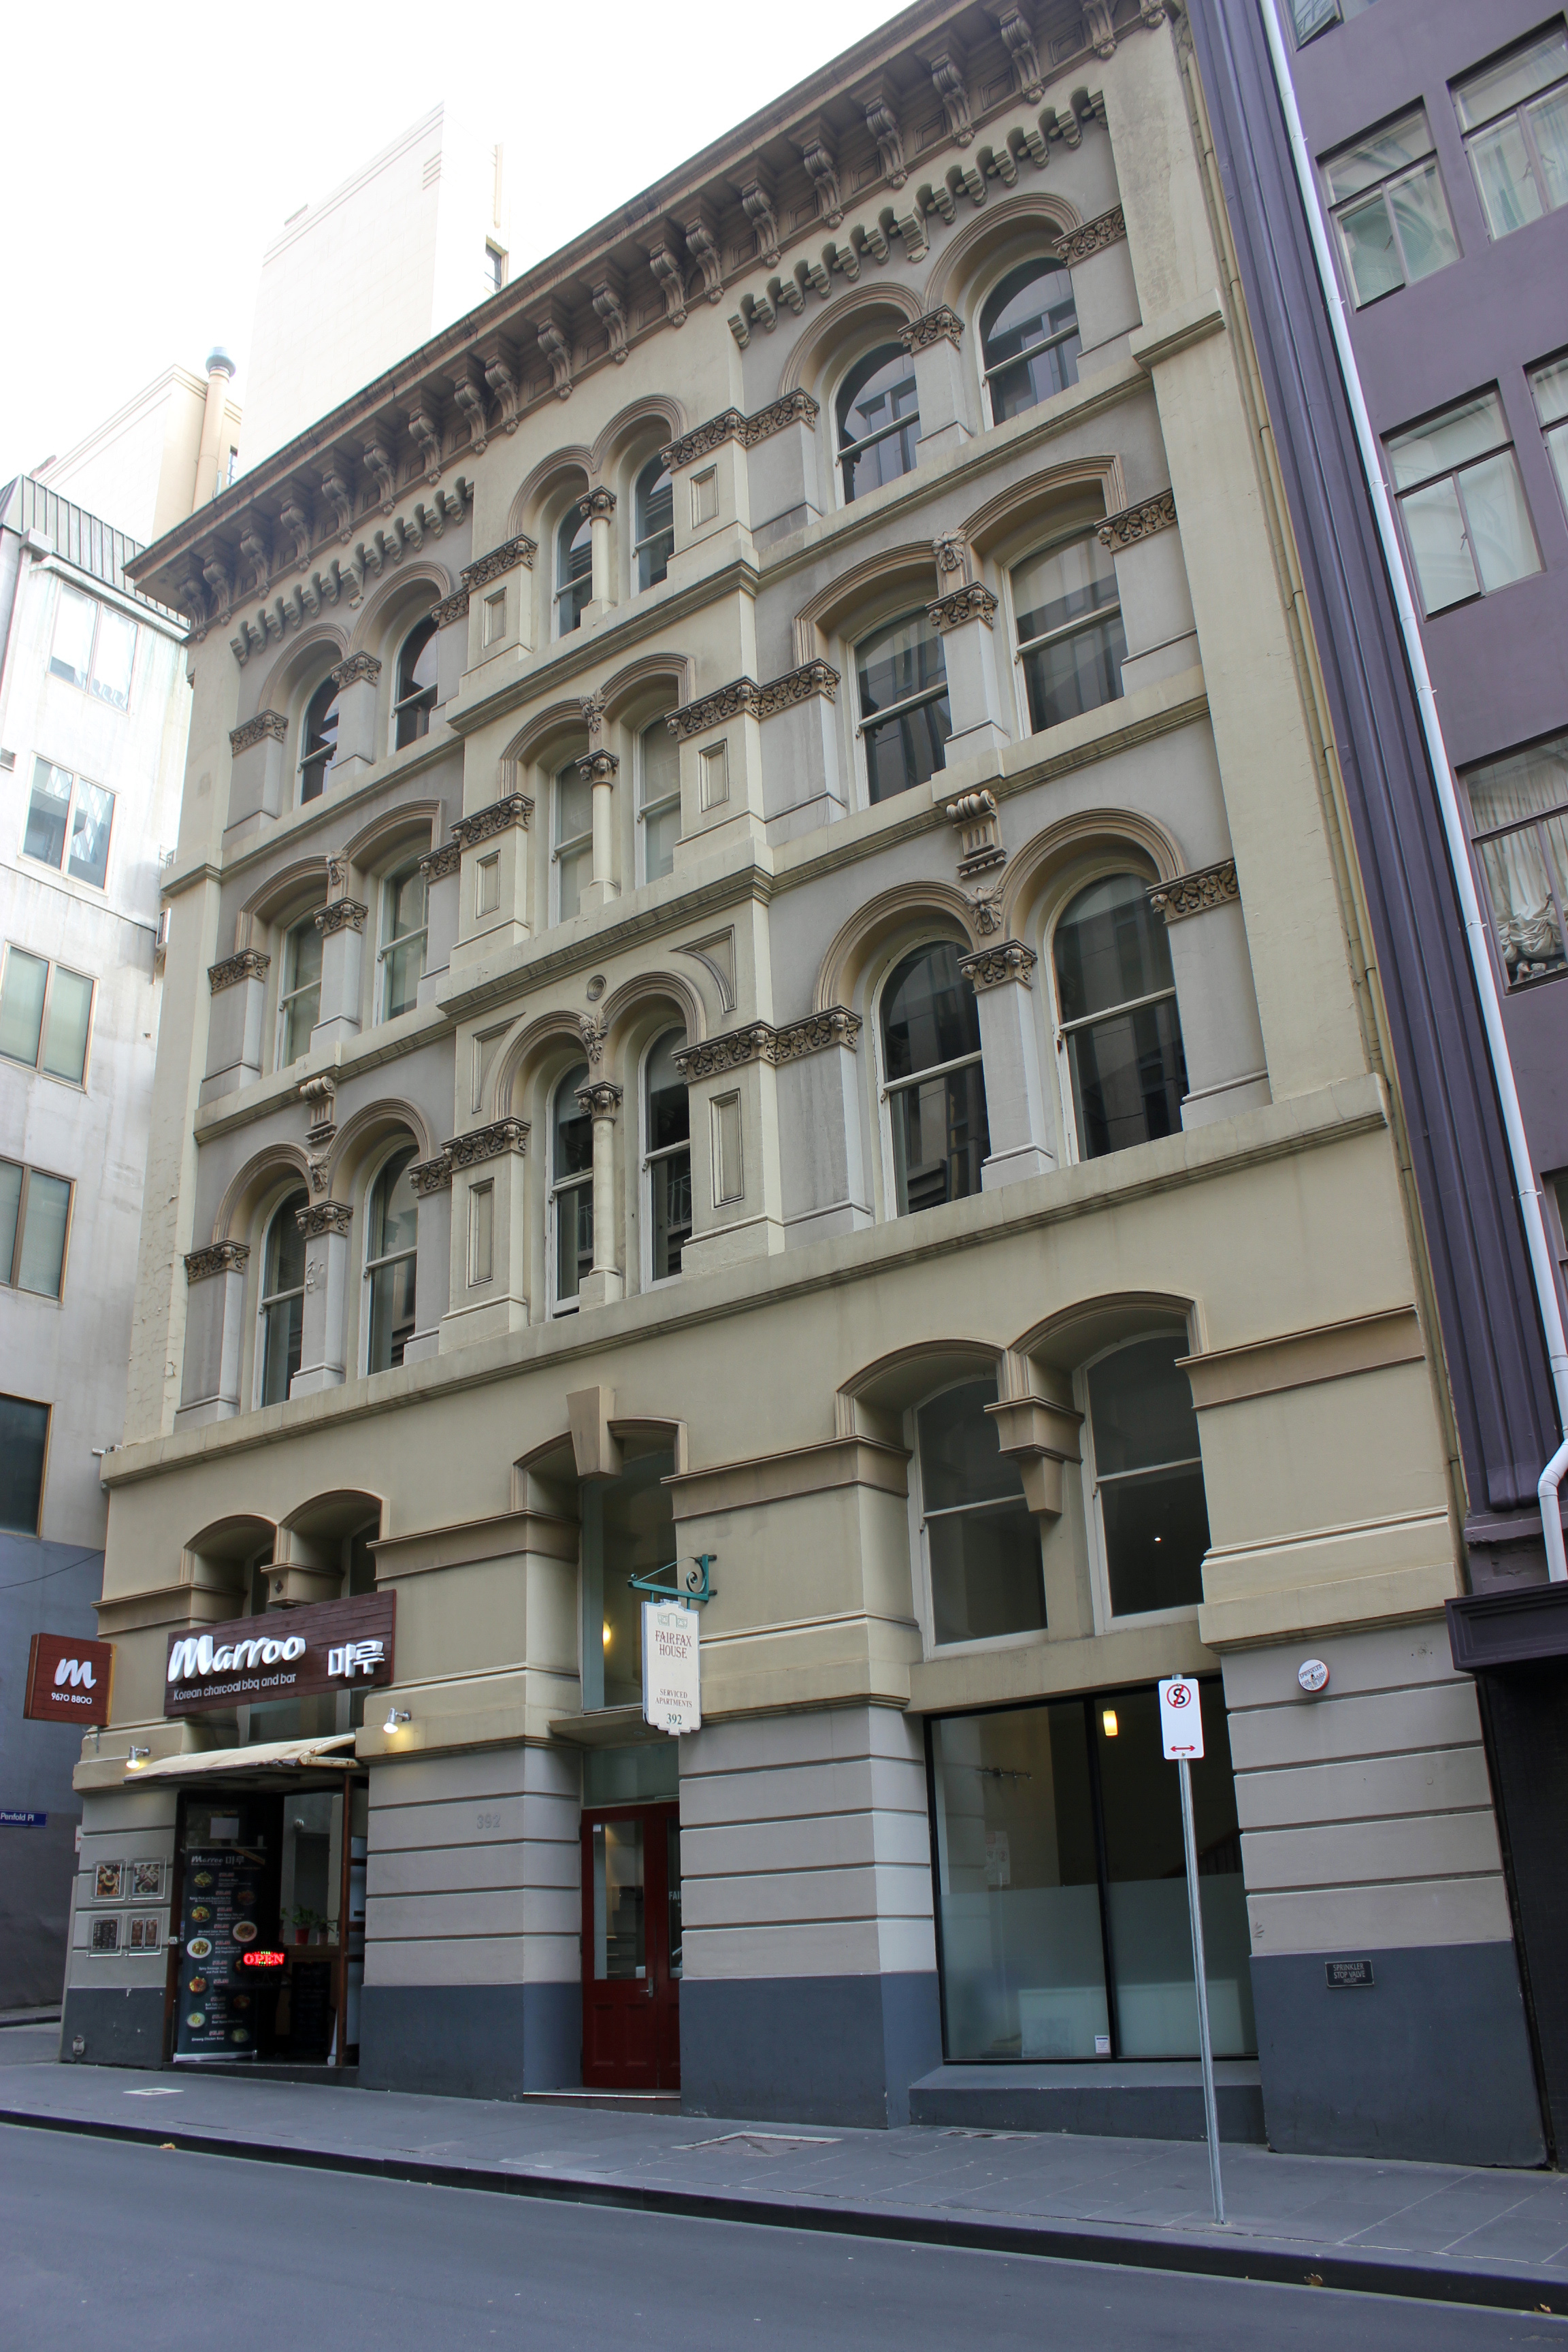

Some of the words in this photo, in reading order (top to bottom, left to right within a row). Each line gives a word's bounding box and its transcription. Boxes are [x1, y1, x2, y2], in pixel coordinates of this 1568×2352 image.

[655, 1630, 692, 1647] FAIRFAX
[659, 1644, 687, 1659] HOUSE
[167, 1635, 306, 1682] Marroo
[327, 1640, 385, 1678] 마루
[1299, 1664, 1322, 1679] SPRINKLER
[174, 1688, 202, 1701] Korean
[203, 1681, 241, 1696] charcoal
[242, 1678, 259, 1690] bbq
[261, 1674, 279, 1687] and
[280, 1673, 296, 1684] bar
[659, 1688, 688, 1699] SERVICED
[51, 1692, 69, 1702] 9670
[71, 1695, 93, 1705] 8800
[655, 1697, 693, 1708] APARTMENTS
[666, 1713, 683, 1725] 392
[0, 1812, 26, 1821] Penfold
[476, 1814, 501, 1829] 392
[191, 1855, 223, 1863] Marroo
[243, 1952, 285, 1966] OPEN
[1333, 1963, 1365, 1972] SPRINKLER
[1333, 1971, 1348, 1979] STOP
